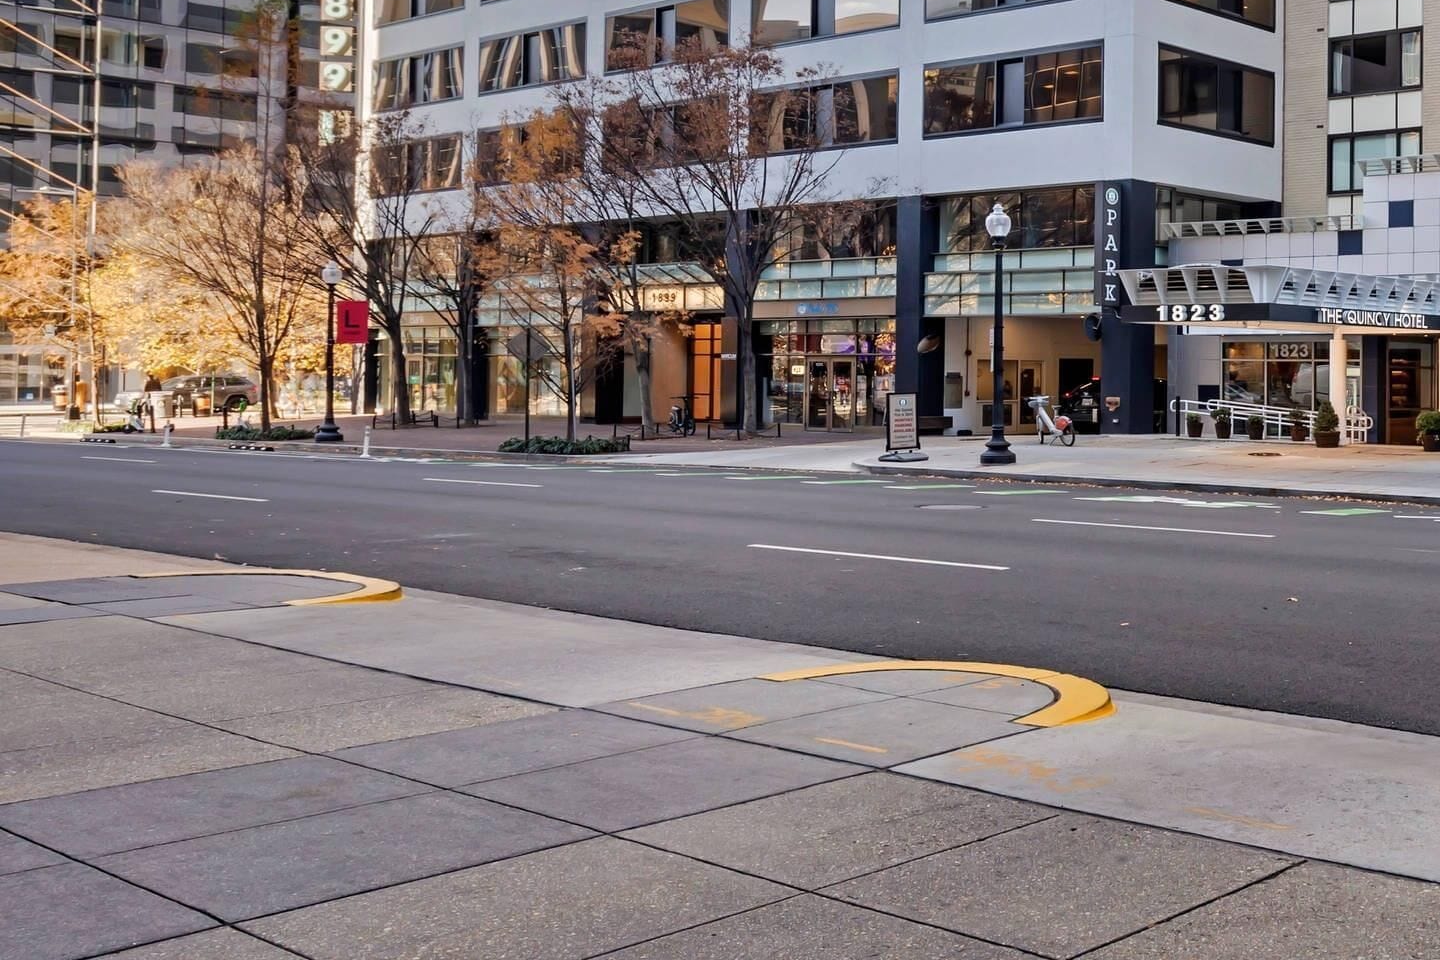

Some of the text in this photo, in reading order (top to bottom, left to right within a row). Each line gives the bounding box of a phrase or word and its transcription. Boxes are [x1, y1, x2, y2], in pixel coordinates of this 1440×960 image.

[1104, 208, 1118, 302] PARK
[652, 292, 677, 303] 1899
[344, 309, 361, 328] L
[1156, 304, 1226, 322] 1823
[1319, 307, 1429, 330] THE QUINCY HOTEL
[1272, 343, 1309, 358] 1823
